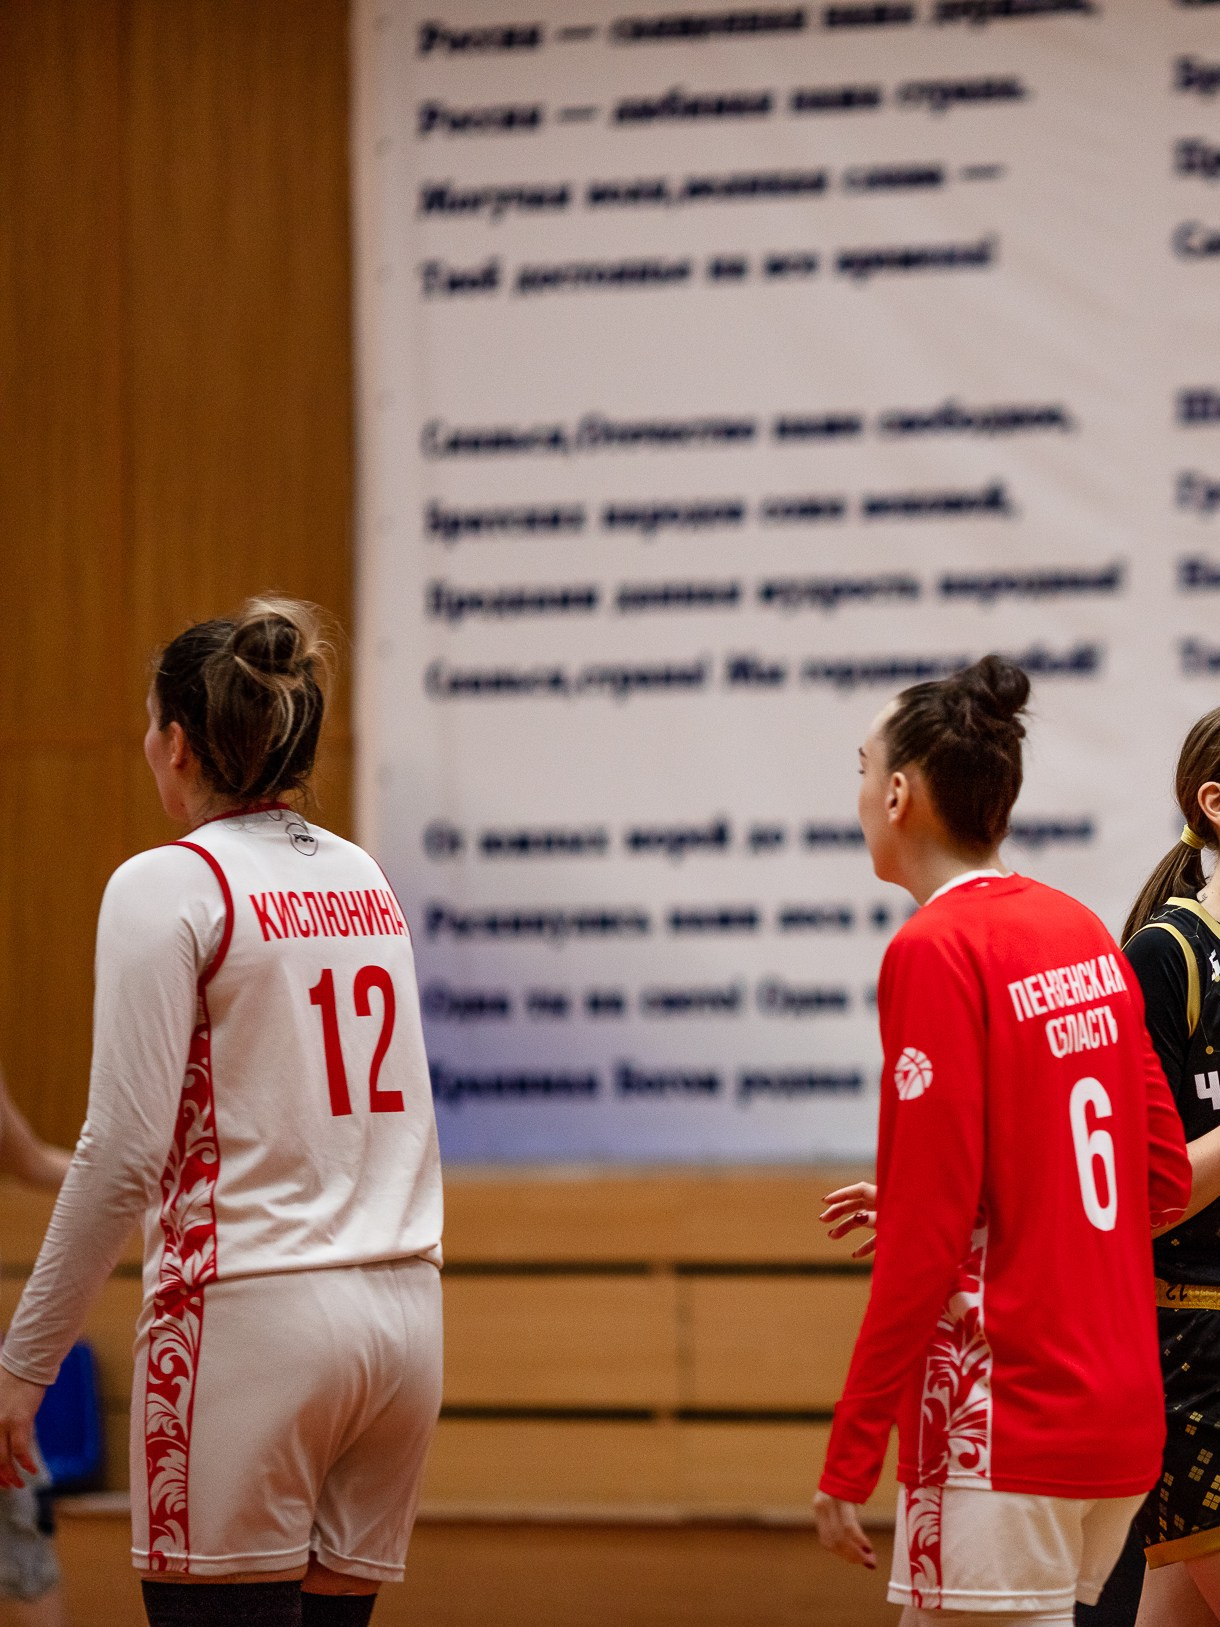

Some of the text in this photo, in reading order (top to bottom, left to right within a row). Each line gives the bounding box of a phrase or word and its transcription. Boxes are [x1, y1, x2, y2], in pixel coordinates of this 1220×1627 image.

[249, 889, 408, 941] КИСЛЮНИНА
[309, 965, 405, 1116] 12
[1046, 1006, 1118, 1058] ОБЛАСТЬ
[1069, 1077, 1118, 1231] 6
